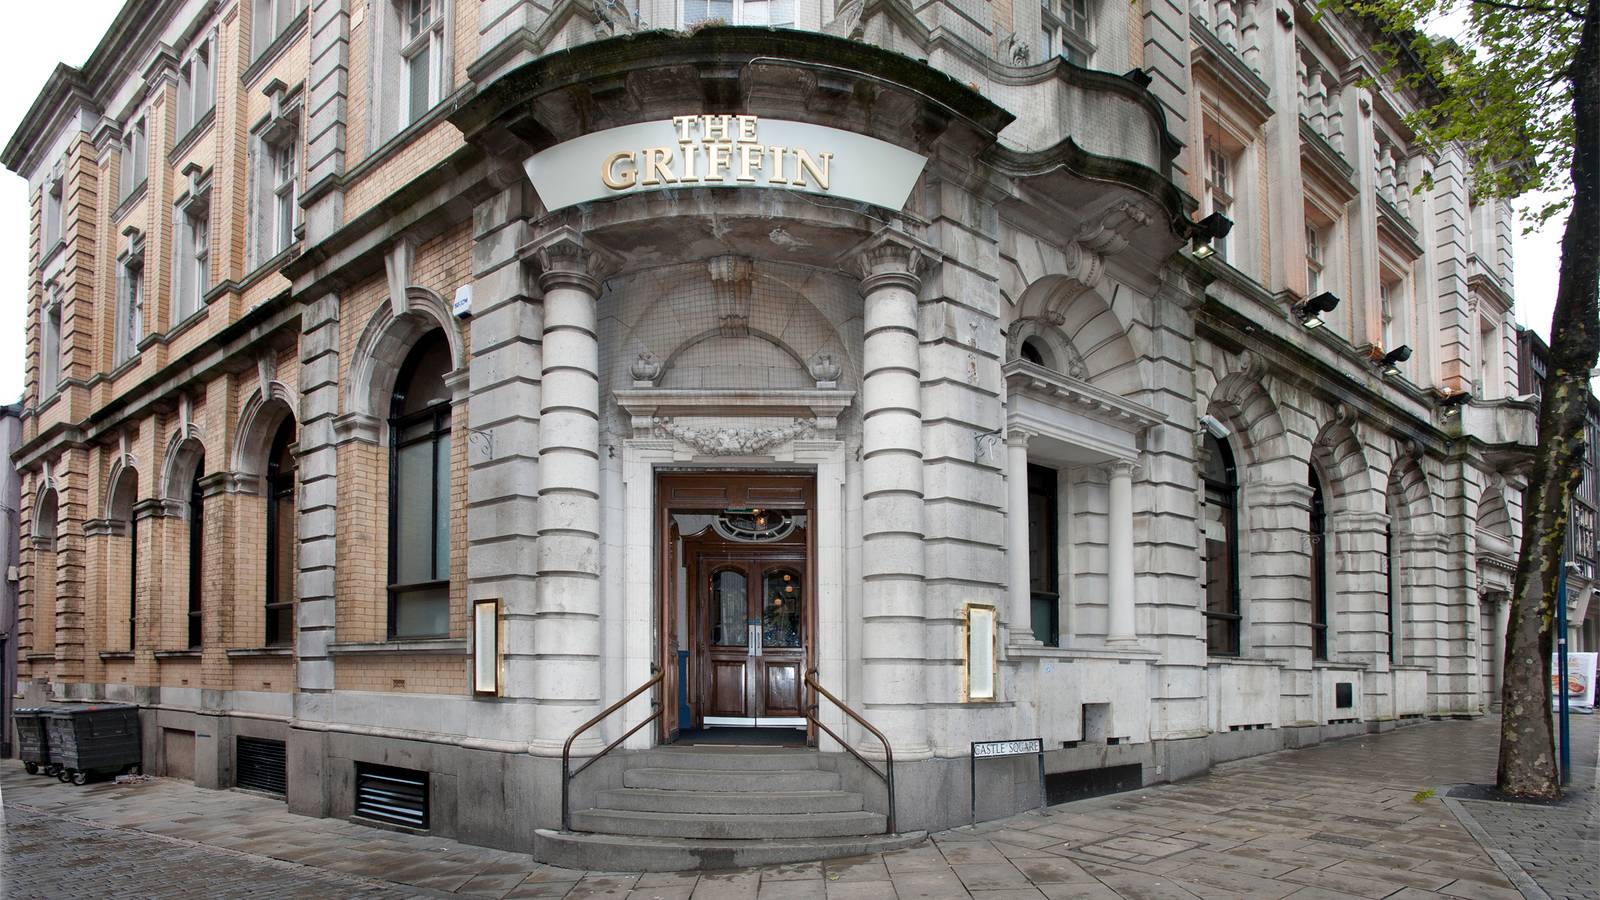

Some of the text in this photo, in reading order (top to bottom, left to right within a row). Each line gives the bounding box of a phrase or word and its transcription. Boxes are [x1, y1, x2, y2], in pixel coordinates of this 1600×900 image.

[673, 114, 758, 144] THE
[601, 143, 833, 190] GRIFFIN
[974, 742, 1038, 755] CASTLE SQUARE
